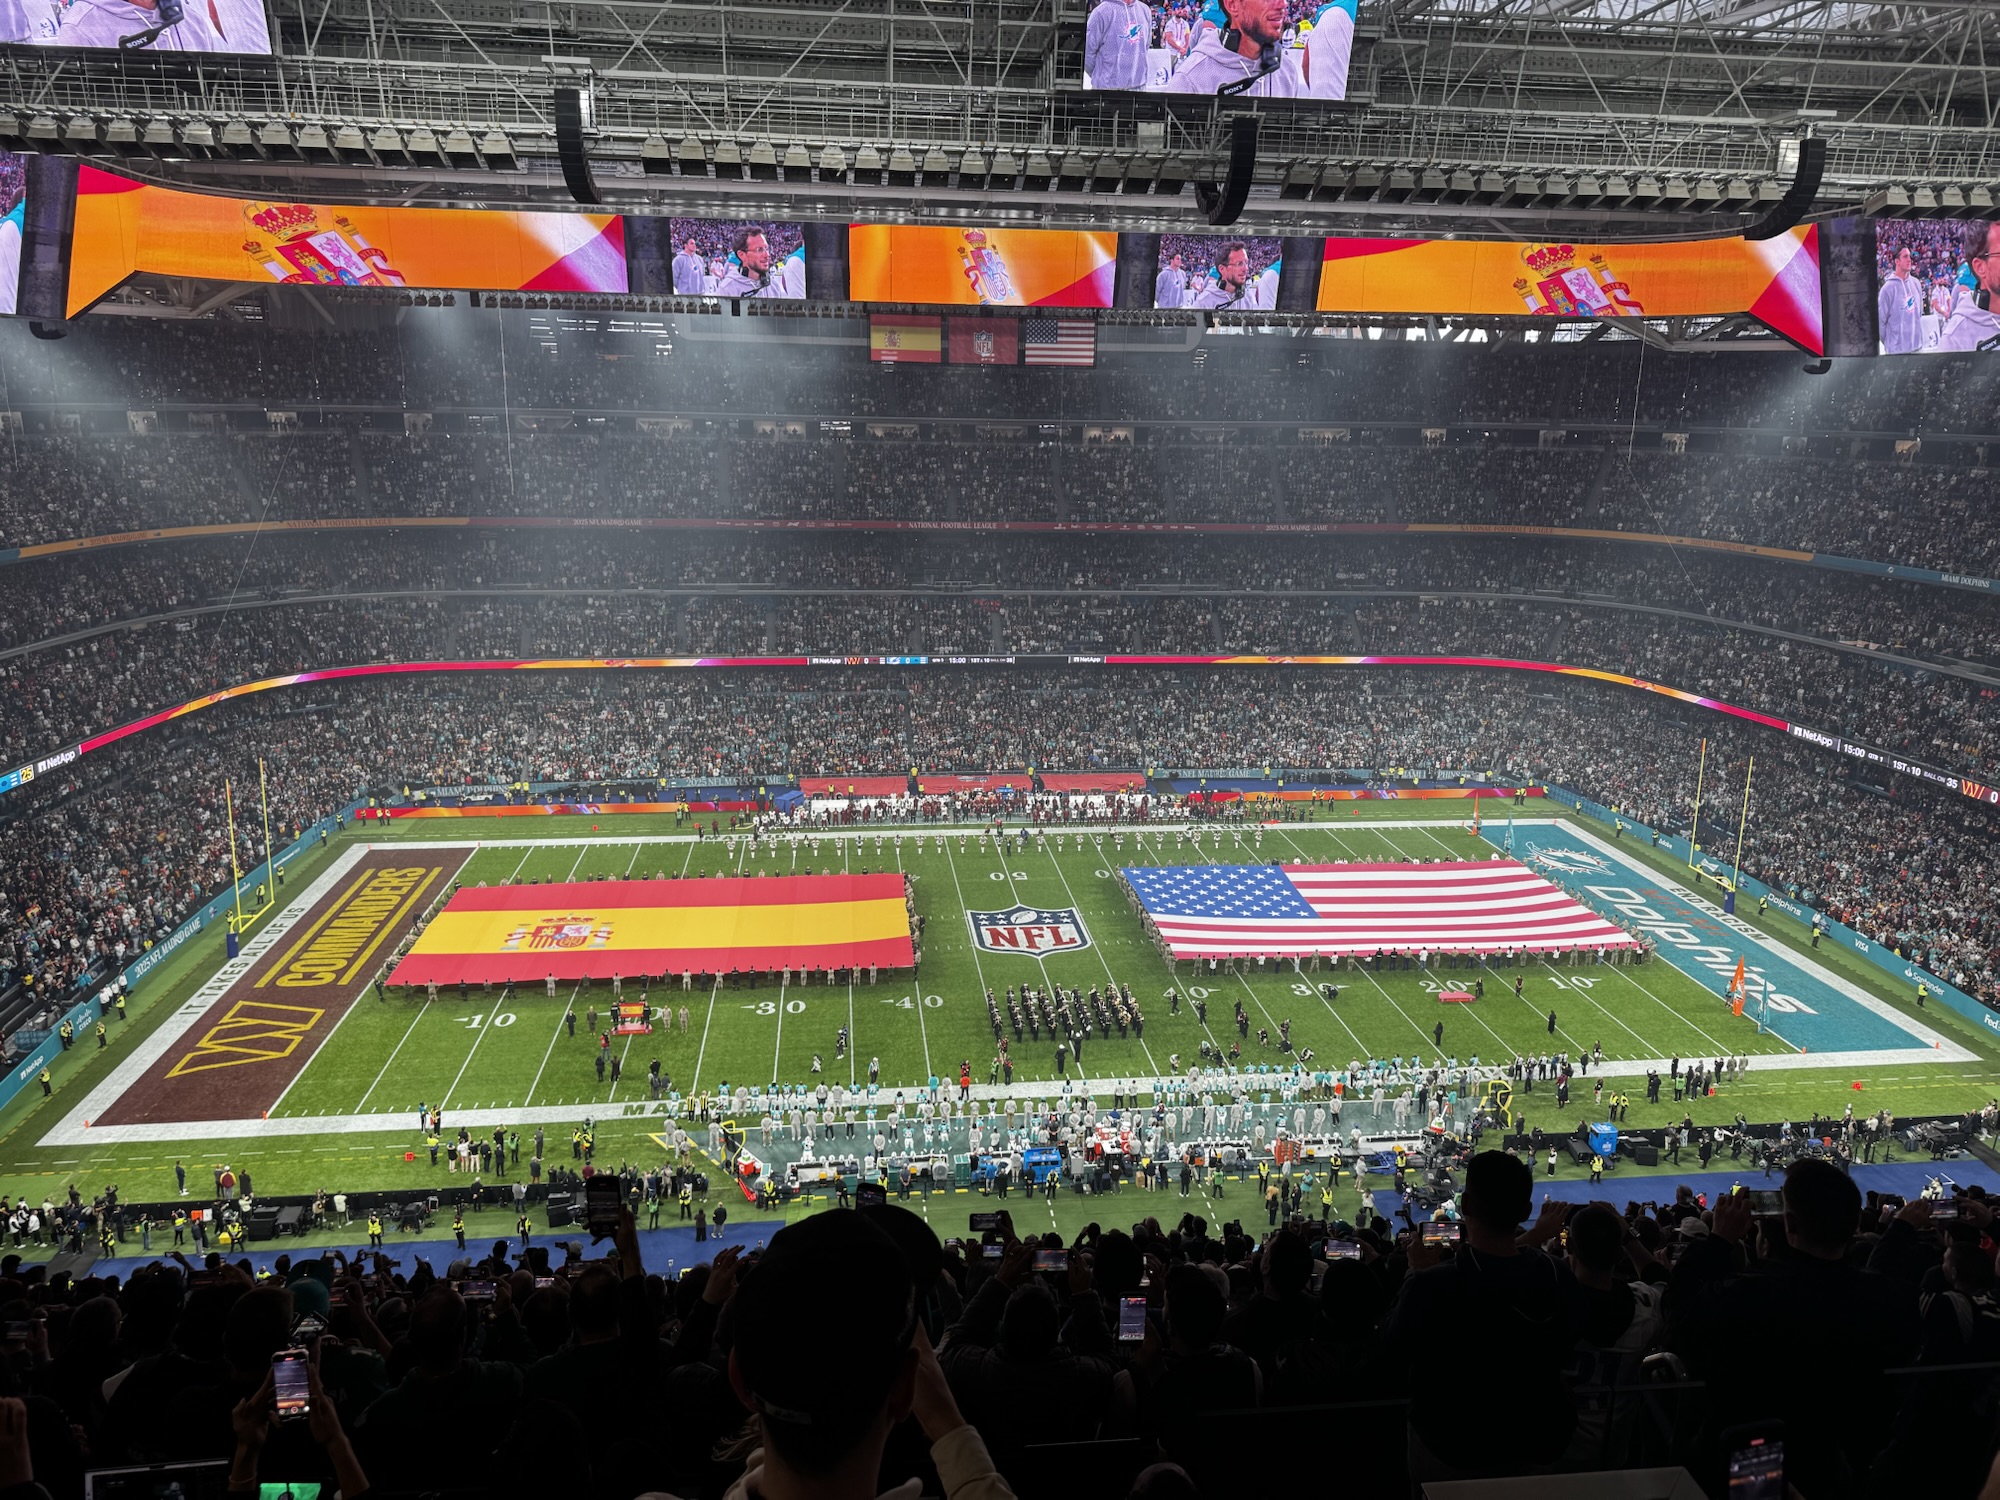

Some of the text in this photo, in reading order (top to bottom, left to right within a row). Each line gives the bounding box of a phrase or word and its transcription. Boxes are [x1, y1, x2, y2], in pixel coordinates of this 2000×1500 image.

[126, 36, 147, 48] SONY
[1224, 84, 1243, 95] SONY
[975, 341, 992, 353] NFL
[908, 521, 939, 529] NATIONAL
[1941, 573, 1990, 588] MIAMI DOLPHINS
[1803, 729, 1832, 747] NetApp
[1844, 744, 1865, 757] 15:00
[22, 751, 76, 781] 25 NetApp
[687, 777, 707, 786] 2025
[708, 777, 723, 786] NFL
[1401, 770, 1426, 779] IAMI
[1893, 761, 1907, 771] 1ST
[1911, 767, 1921, 776] 10
[1924, 771, 1937, 780] BALL
[1946, 778, 1958, 788] 35
[1991, 791, 1998, 803] 0
[1658, 838, 1672, 849] Adobe
[1636, 888, 1732, 937] MIAMI
[1768, 893, 1802, 917] Dolphins
[1669, 887, 1770, 941] END RACISM
[275, 867, 427, 988] COMMANDERS
[986, 926, 1077, 950] NFL
[1855, 938, 1869, 953] VISA
[135, 956, 151, 978] 2025
[150, 949, 163, 966] NFL
[184, 917, 202, 938] GAME
[1584, 886, 1819, 1015] Dolphins
[179, 907, 305, 1016] IT TAKES ALL OF US
[1419, 980, 1467, 994] 20
[1548, 976, 1593, 990] 10
[1912, 972, 1945, 996] Santander
[1163, 986, 1208, 999] 40
[755, 1000, 807, 1015] 30
[895, 995, 943, 1009] 40
[465, 1013, 517, 1028] 10
[26, 1055, 44, 1075] NetApp
